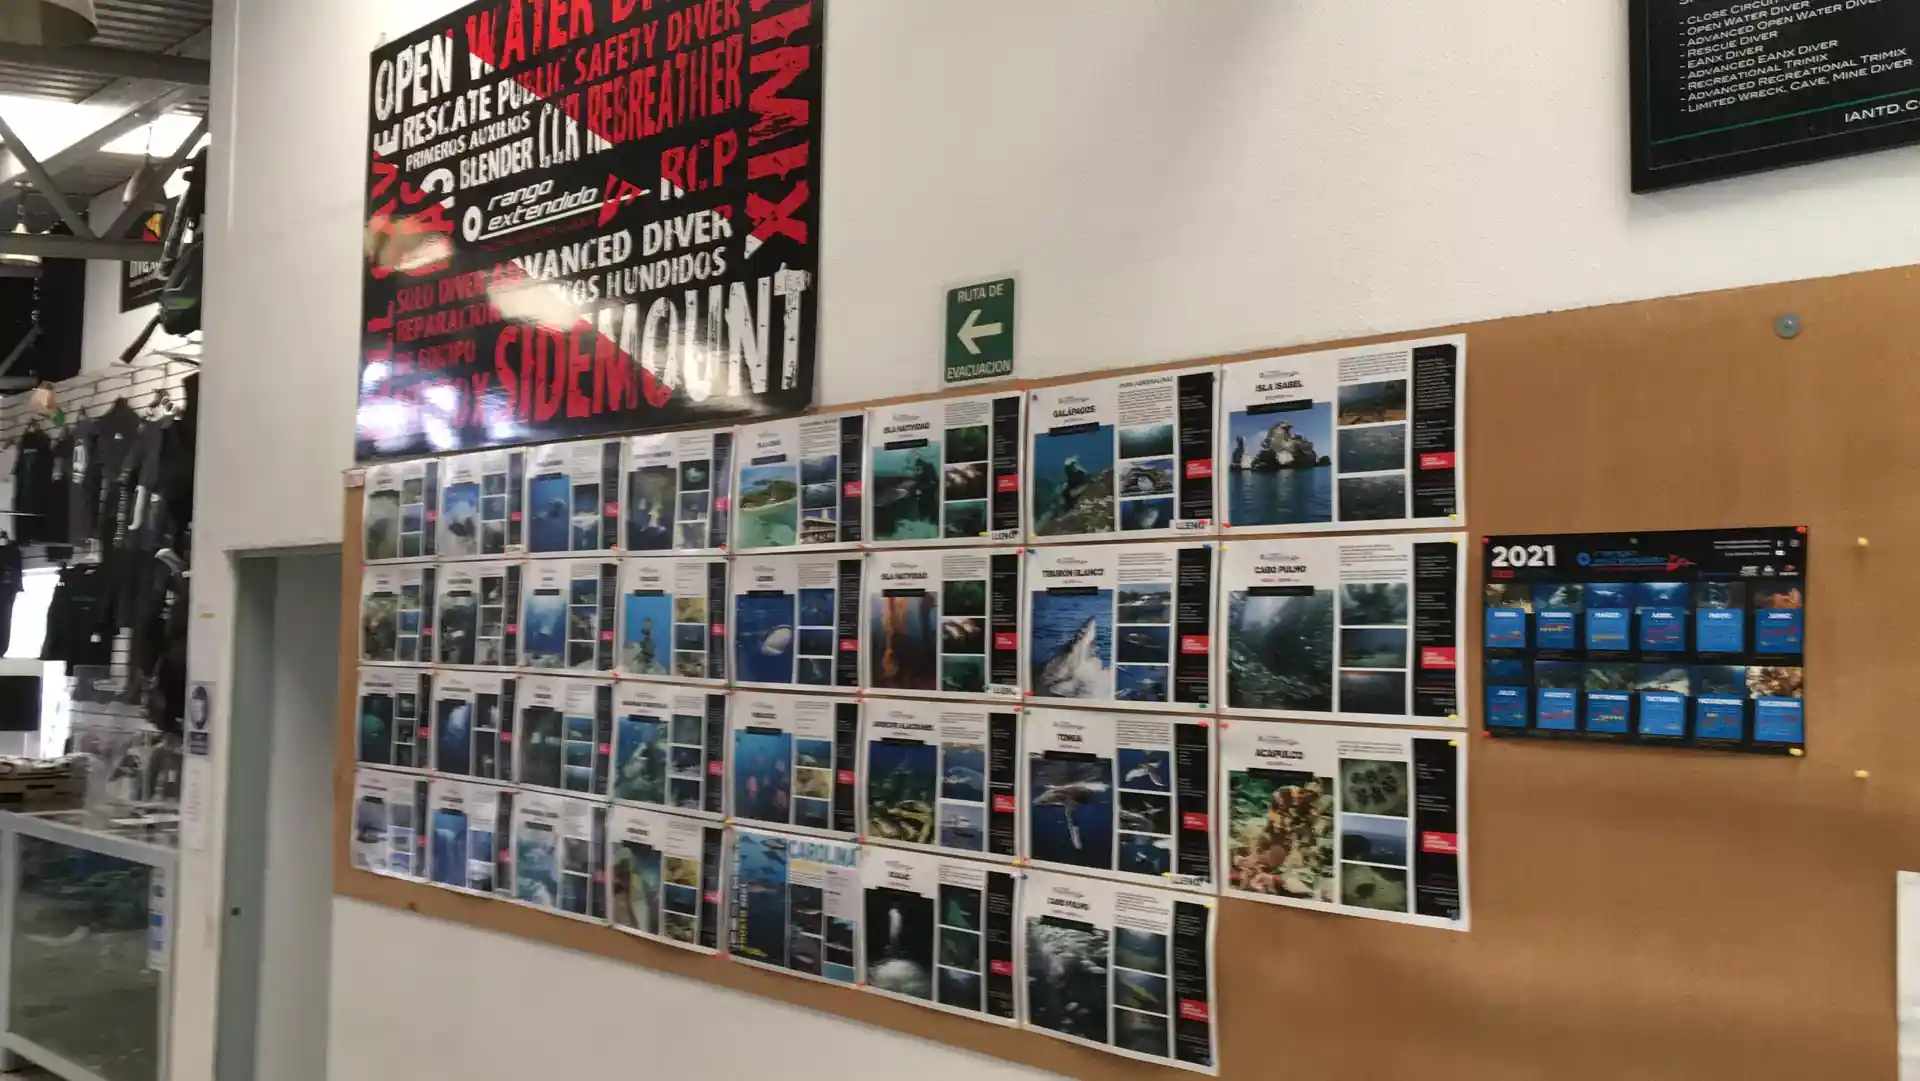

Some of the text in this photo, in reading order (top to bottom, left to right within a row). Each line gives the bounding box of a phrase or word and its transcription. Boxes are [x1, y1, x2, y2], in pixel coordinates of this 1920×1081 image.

[1687, 9, 1728, 25] CLOSE
[1687, 0, 1811, 36] OPEN WATER DIVER
[1687, 25, 1754, 47] ADVANCED
[1757, 15, 1793, 30] OPEN
[1795, 3, 1842, 21] WATER
[375, 0, 594, 120] OPEN WATER
[498, 0, 741, 115] PUBLIC SAFETY DIVER
[1687, 30, 1778, 58] RESCUE DIVER
[1687, 58, 1755, 80] ADVANCED
[1798, 39, 1840, 55] DIVER
[1725, 45, 1764, 60] DIVER
[1687, 47, 1908, 101] ADVANCED RECREATIONAL TRIMIX
[1688, 53, 1828, 90] RECREATIONAL TRIMIX
[1688, 96, 1736, 113] LIMITED
[1832, 67, 1868, 82] MINE
[1870, 58, 1914, 75] DIVER
[402, 84, 492, 150] RESCATE
[460, 136, 534, 190] BLENDER
[587, 33, 743, 155] REBREATHER
[744, 0, 812, 260] IMIX
[1845, 99, 1920, 123] IANTD.C
[406, 110, 531, 172] PRIMEROS AUXILIOS
[660, 130, 739, 201] RCP
[487, 179, 555, 211] rango
[488, 186, 599, 231] extendido
[643, 210, 732, 256] DIVER
[606, 246, 726, 299] HUNDIDOS
[957, 284, 1004, 302] RUTA DE
[495, 262, 812, 422] SIDEMOUNT
[1255, 379, 1303, 392] ISLA ISABEL
[1491, 545, 1556, 567] 2021
